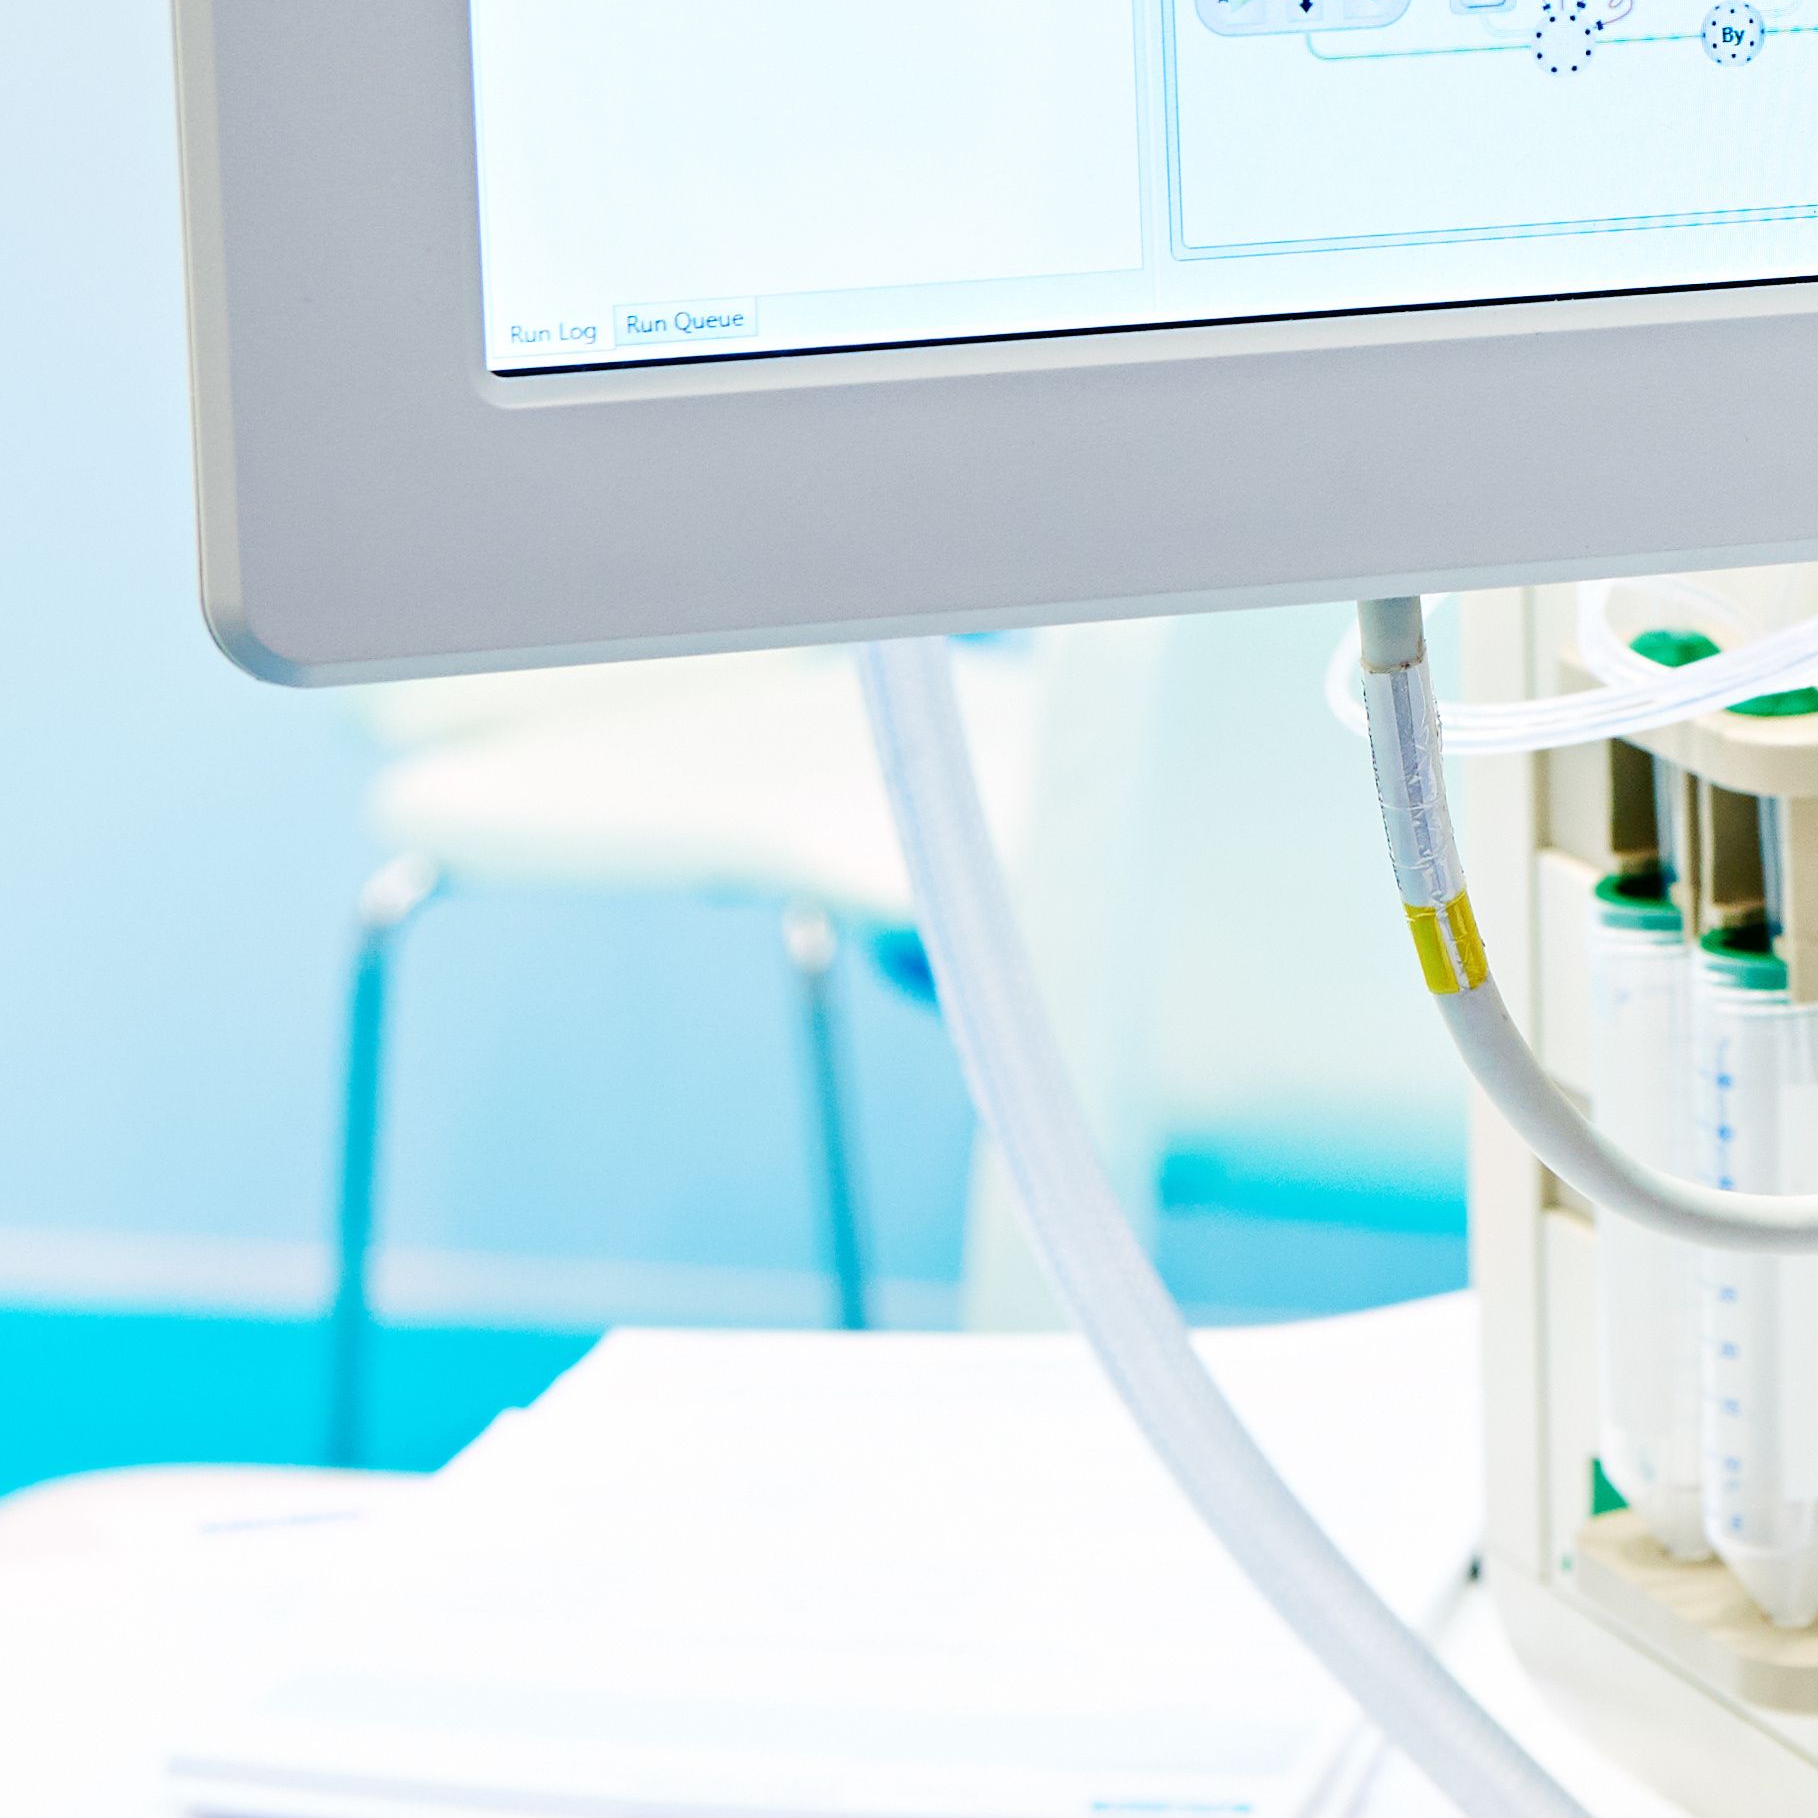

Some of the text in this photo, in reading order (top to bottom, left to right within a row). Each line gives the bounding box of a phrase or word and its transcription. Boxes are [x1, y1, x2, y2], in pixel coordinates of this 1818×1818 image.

[1721, 27, 1745, 46] By
[510, 311, 744, 345] Run Log Run Queue
